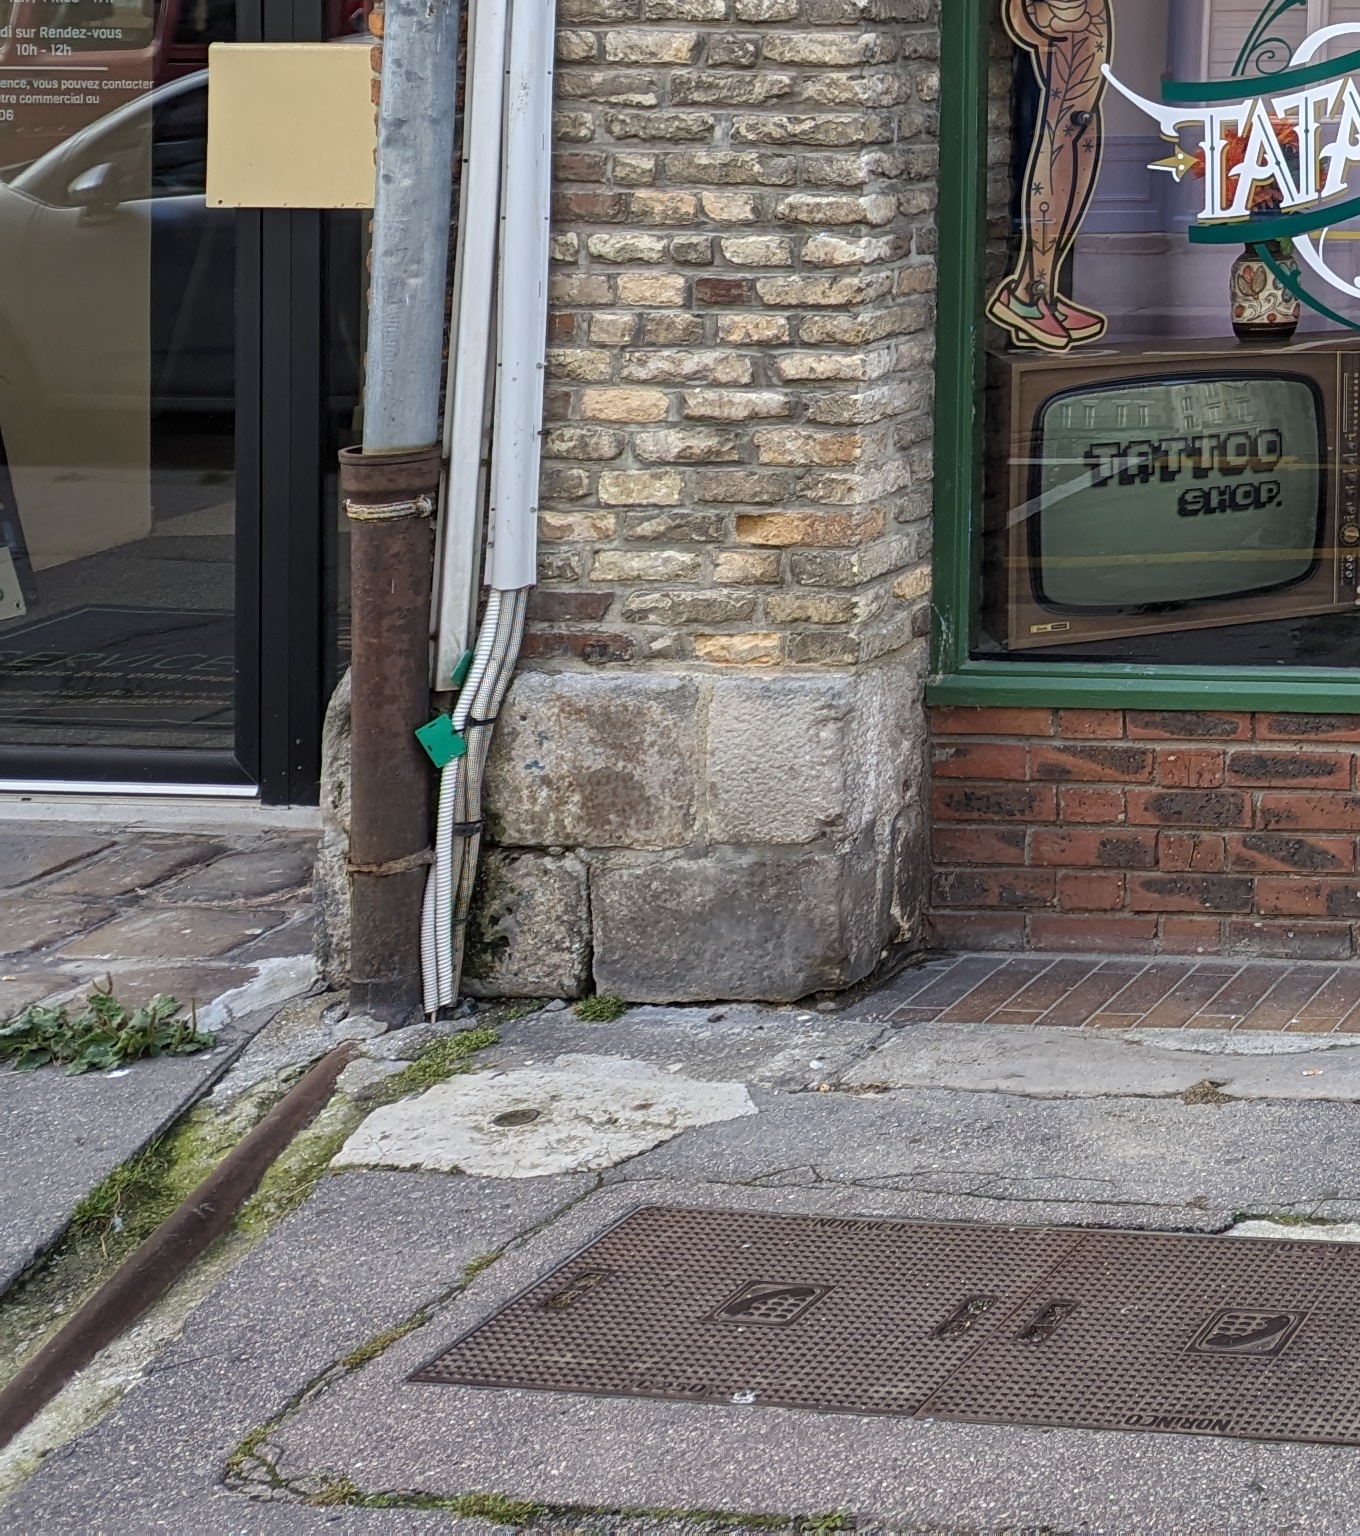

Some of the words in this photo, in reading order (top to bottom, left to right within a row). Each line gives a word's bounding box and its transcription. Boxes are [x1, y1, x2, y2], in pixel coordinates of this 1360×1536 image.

[0, 26, 12, 38] di
[15, 29, 36, 38] sur
[40, 27, 122, 39] Rendez-vous
[16, 44, 37, 56] 10h
[50, 44, 72, 56] 12h
[32, 80, 58, 89] vous
[61, 81, 99, 91] pouvez
[102, 80, 154, 89] contacter
[19, 94, 83, 103] commercial
[1085, 428, 1283, 486] TATTOO
